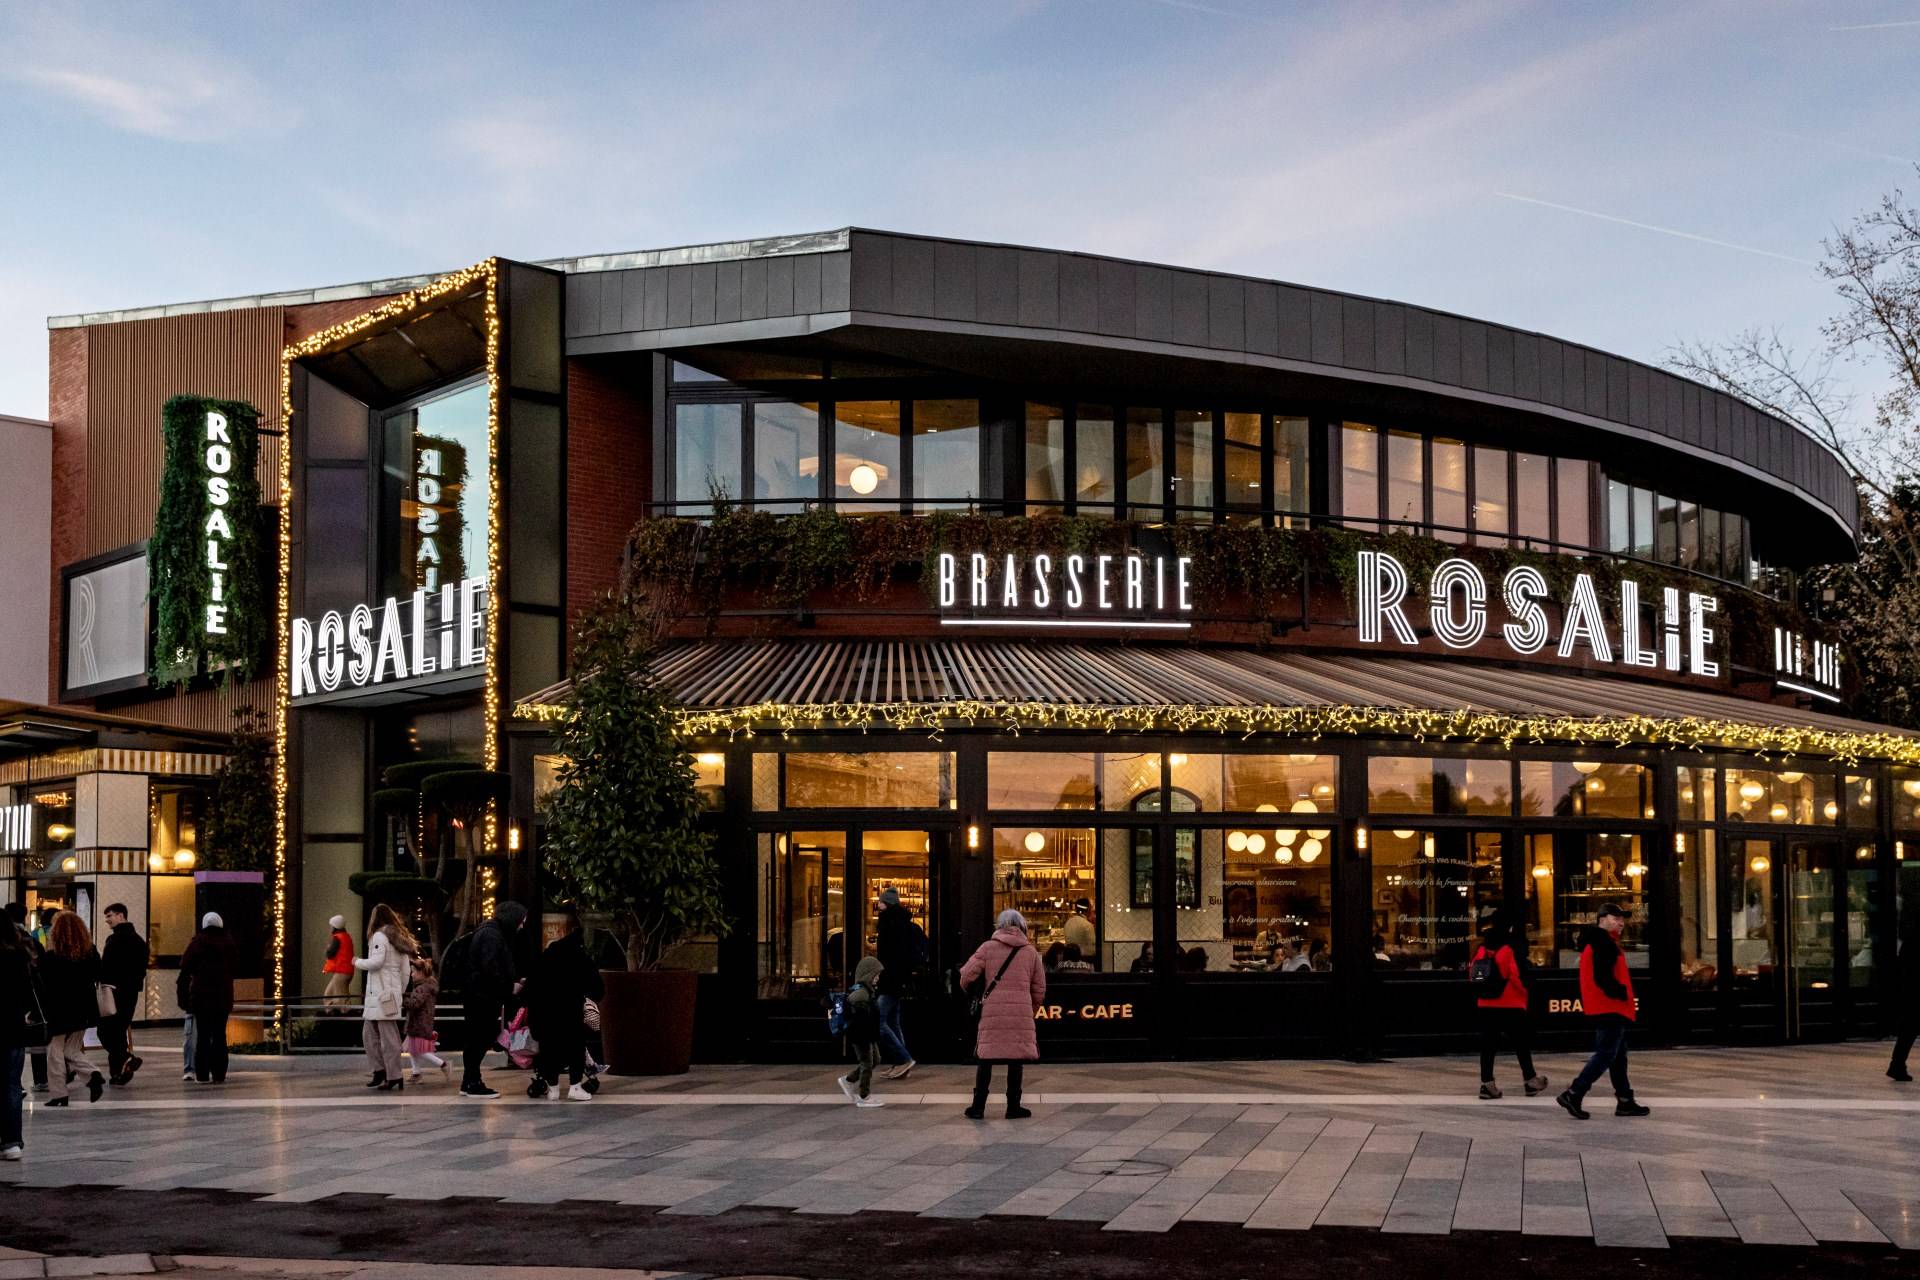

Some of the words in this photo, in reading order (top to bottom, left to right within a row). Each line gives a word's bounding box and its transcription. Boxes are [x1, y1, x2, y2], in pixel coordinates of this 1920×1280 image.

[206, 412, 231, 634] ROSALIE
[940, 553, 1192, 610] BRASSERIE
[291, 575, 487, 696] ROSALIE
[1358, 551, 1718, 677] ROSALIE
[1034, 1005, 1062, 1019] AR
